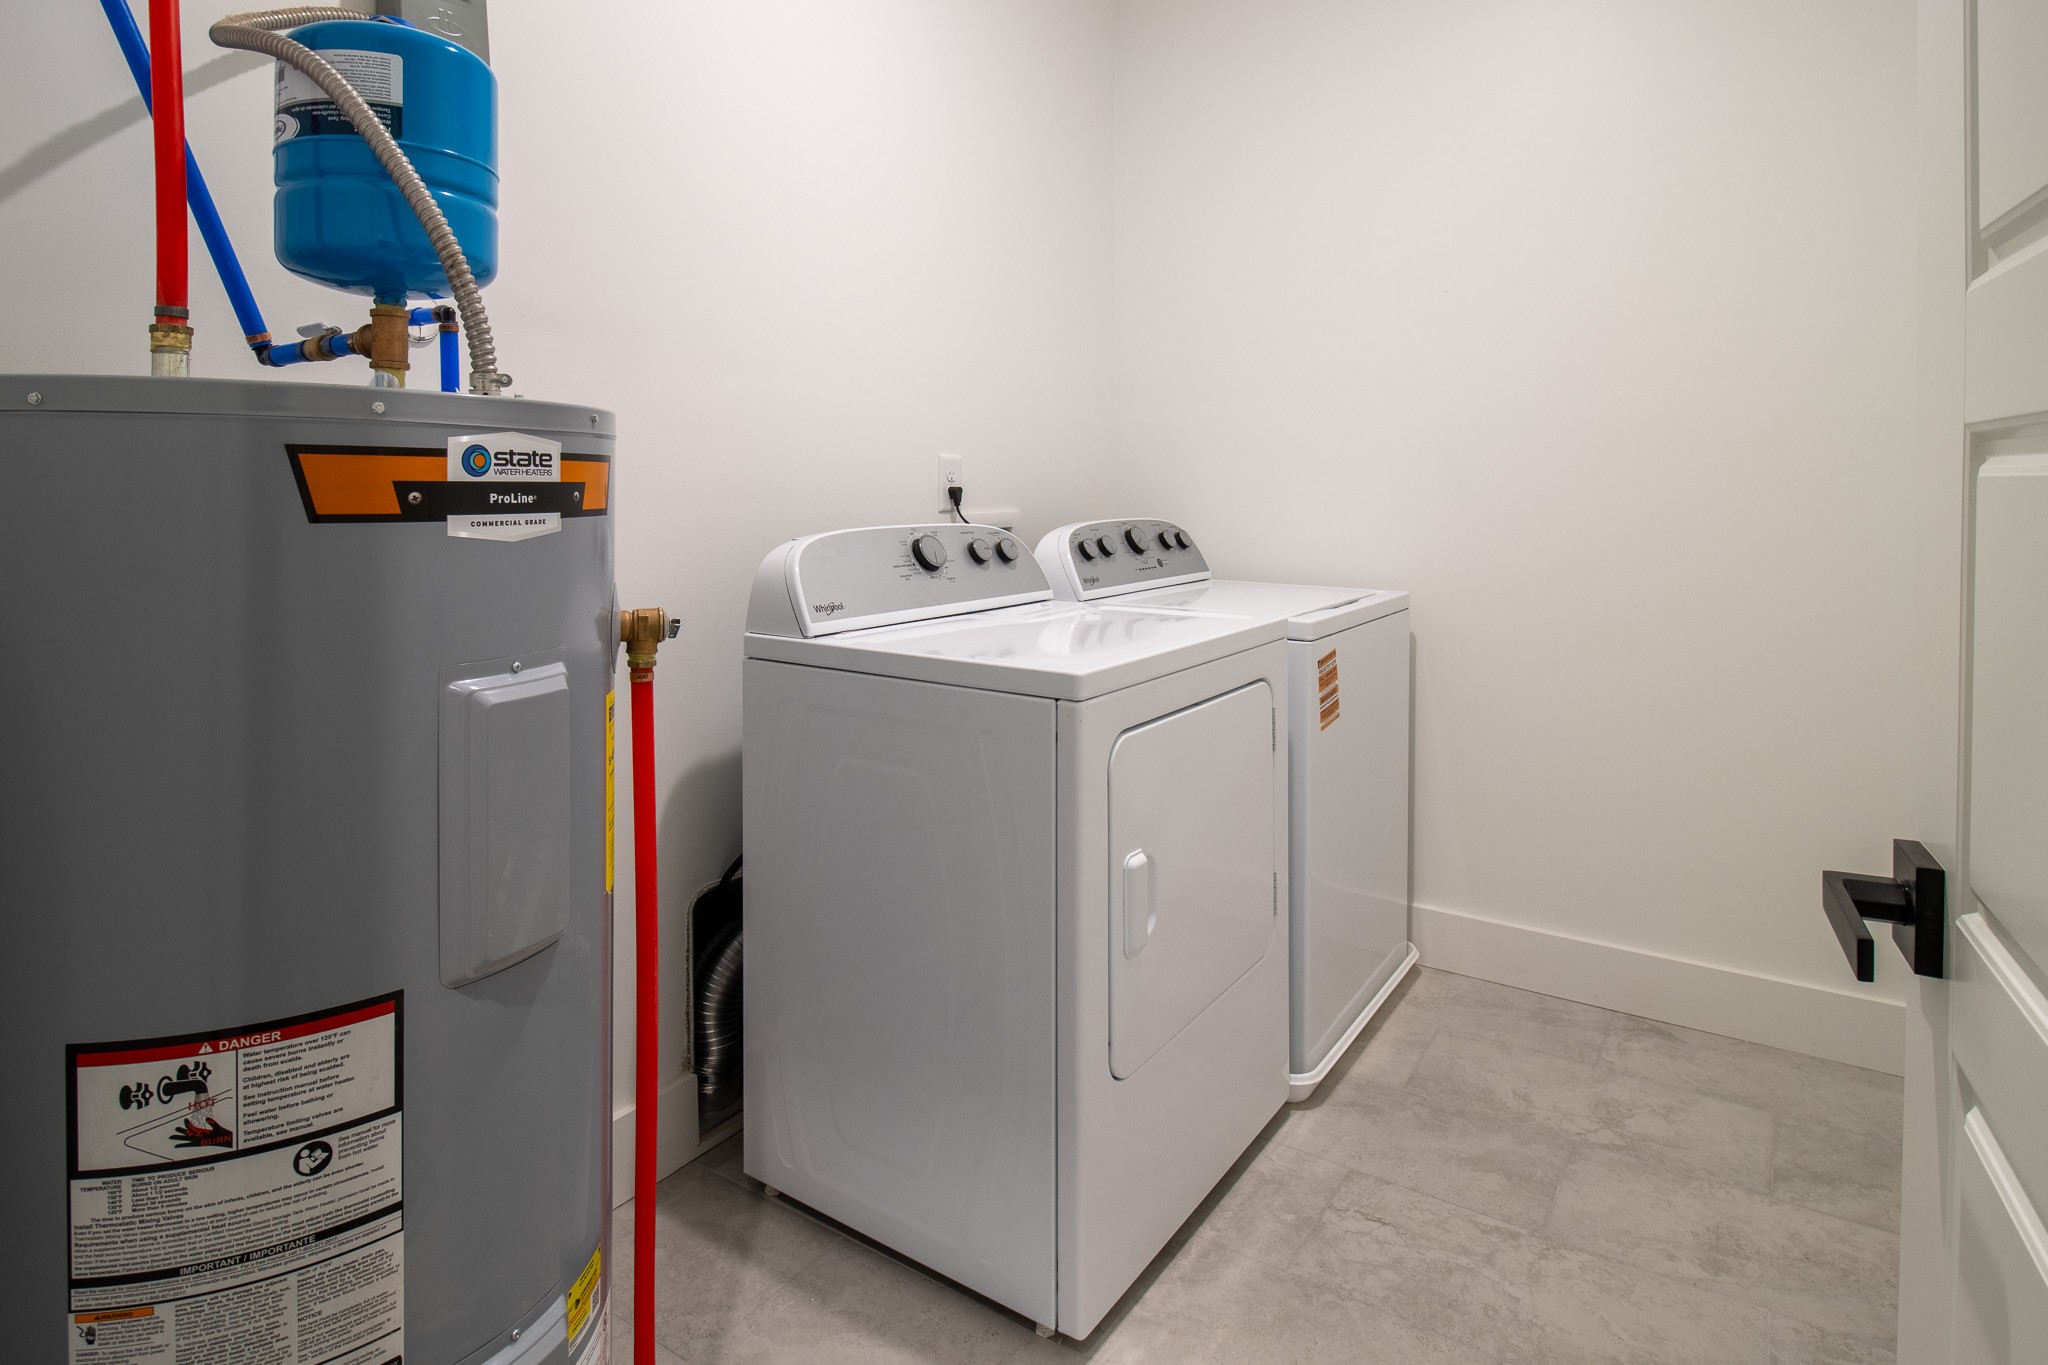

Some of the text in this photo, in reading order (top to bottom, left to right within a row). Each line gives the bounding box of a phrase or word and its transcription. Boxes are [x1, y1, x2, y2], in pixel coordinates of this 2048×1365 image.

[493, 449, 553, 468] state
[812, 601, 845, 616] Whirlpool
[219, 1031, 281, 1051] DANGER
[243, 1050, 262, 1058] Water
[264, 1041, 303, 1053] temperature
[321, 1032, 338, 1040] 125°F
[243, 1057, 263, 1065] cause
[264, 1052, 286, 1060] severe
[308, 1041, 335, 1051] instantly
[243, 1063, 261, 1072] death
[280, 1055, 303, 1064] scalds.
[243, 1072, 273, 1082] Children,
[275, 1064, 302, 1075] disabled
[317, 1056, 338, 1065] elderly
[251, 1077, 276, 1088] highest
[299, 1068, 317, 1076] being
[319, 1061, 345, 1071] scalded.
[243, 1098, 265, 1107] setting
[267, 1088, 306, 1101] temperature
[335, 1077, 355, 1085] heater.
[257, 1085, 292, 1097] instruction
[294, 1079, 317, 1089] manual
[319, 1075, 339, 1083] before
[188, 1098, 218, 1111] HOT
[243, 1110, 257, 1118] Feel
[259, 1106, 277, 1114] water
[278, 1101, 299, 1109] before
[301, 1095, 325, 1104] bathing
[243, 1114, 279, 1125] showering.
[243, 1122, 284, 1135] Temperature
[286, 1115, 310, 1125] limiting
[311, 1110, 331, 1118] valves
[289, 1121, 314, 1131] manual.
[351, 1126, 372, 1138] manual
[382, 1120, 396, 1128] more
[200, 1134, 232, 1147] BURN
[338, 1128, 386, 1148] information about
[338, 1136, 384, 1155] preventing burns
[338, 1152, 351, 1160] from
[157, 1170, 186, 1178] PRODUCE
[188, 1166, 215, 1174] SERIOUS
[80, 1184, 121, 1192] TEMPERATURE
[74, 1240, 118, 1248] Requirements
[165, 1225, 210, 1238] supplemental
[211, 1221, 226, 1229] heat
[228, 1218, 250, 1226] source
[95, 1219, 137, 1228] Thermostatic
[179, 1256, 242, 1275] IMPORTANT
[249, 1235, 316, 1260] IMPORTANTE
[100, 1312, 134, 1320] WARNING
[297, 1310, 323, 1323] NOTICE
